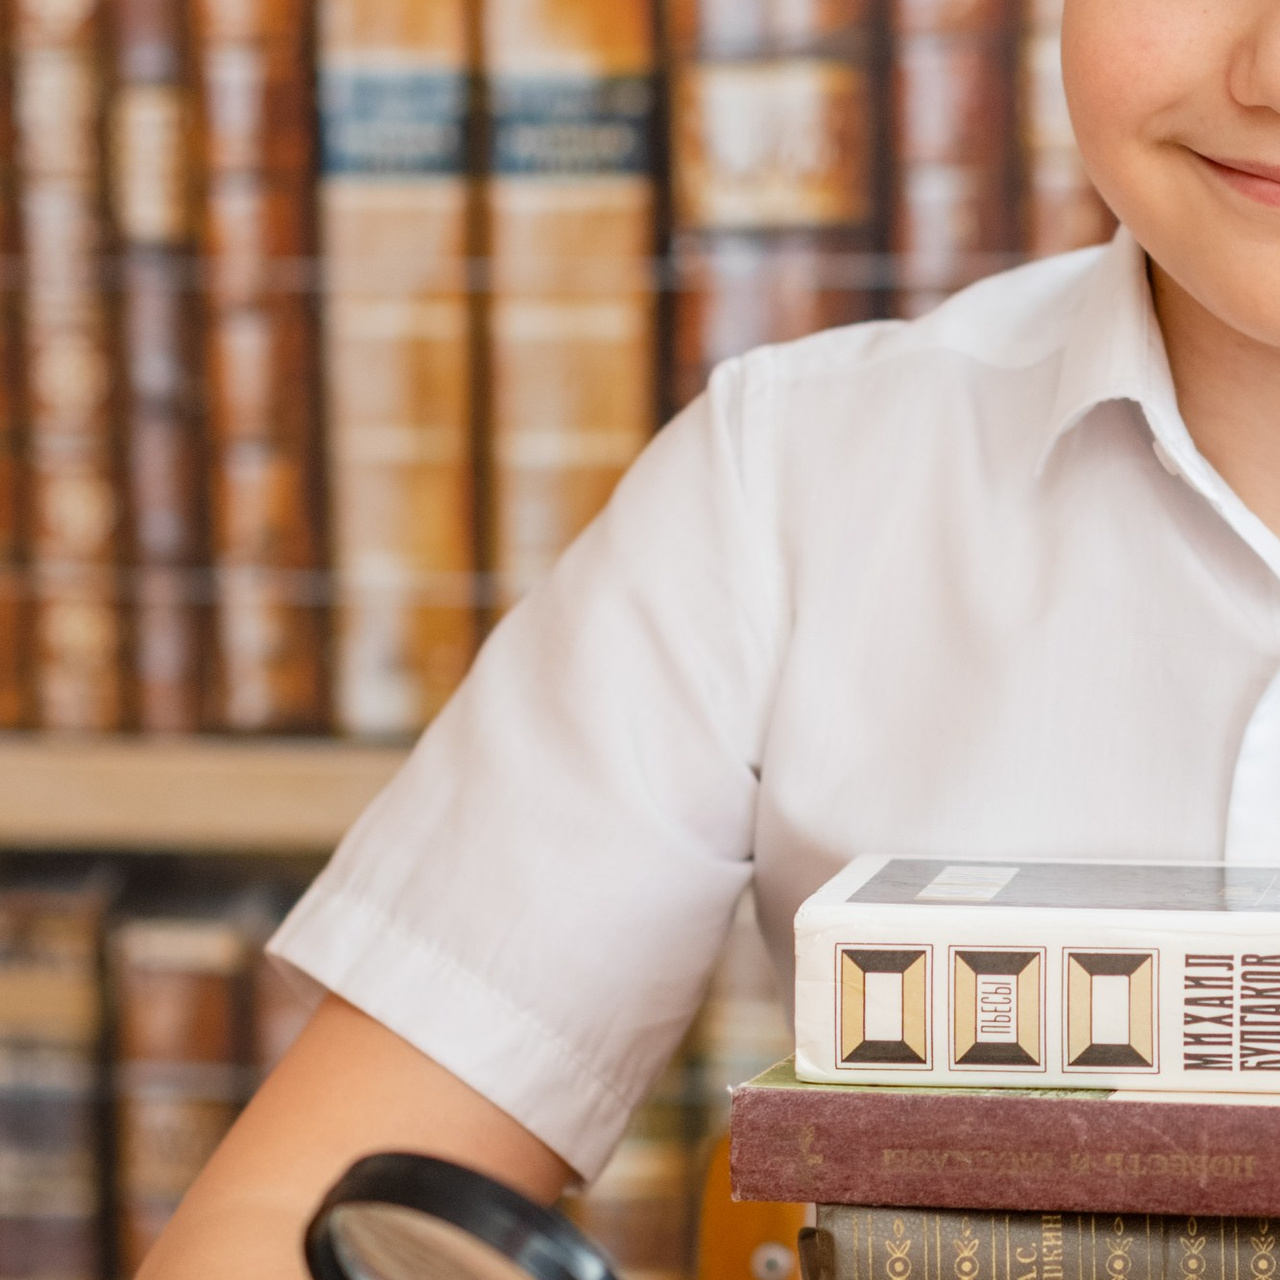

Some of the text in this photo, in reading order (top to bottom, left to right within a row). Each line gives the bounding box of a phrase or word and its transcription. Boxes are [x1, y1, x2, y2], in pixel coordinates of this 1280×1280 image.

[980, 981, 1012, 1034] ПЬЕСЫ
[1183, 953, 1234, 1071] МИХАИЛ
[1070, 1151, 1091, 1175] И
